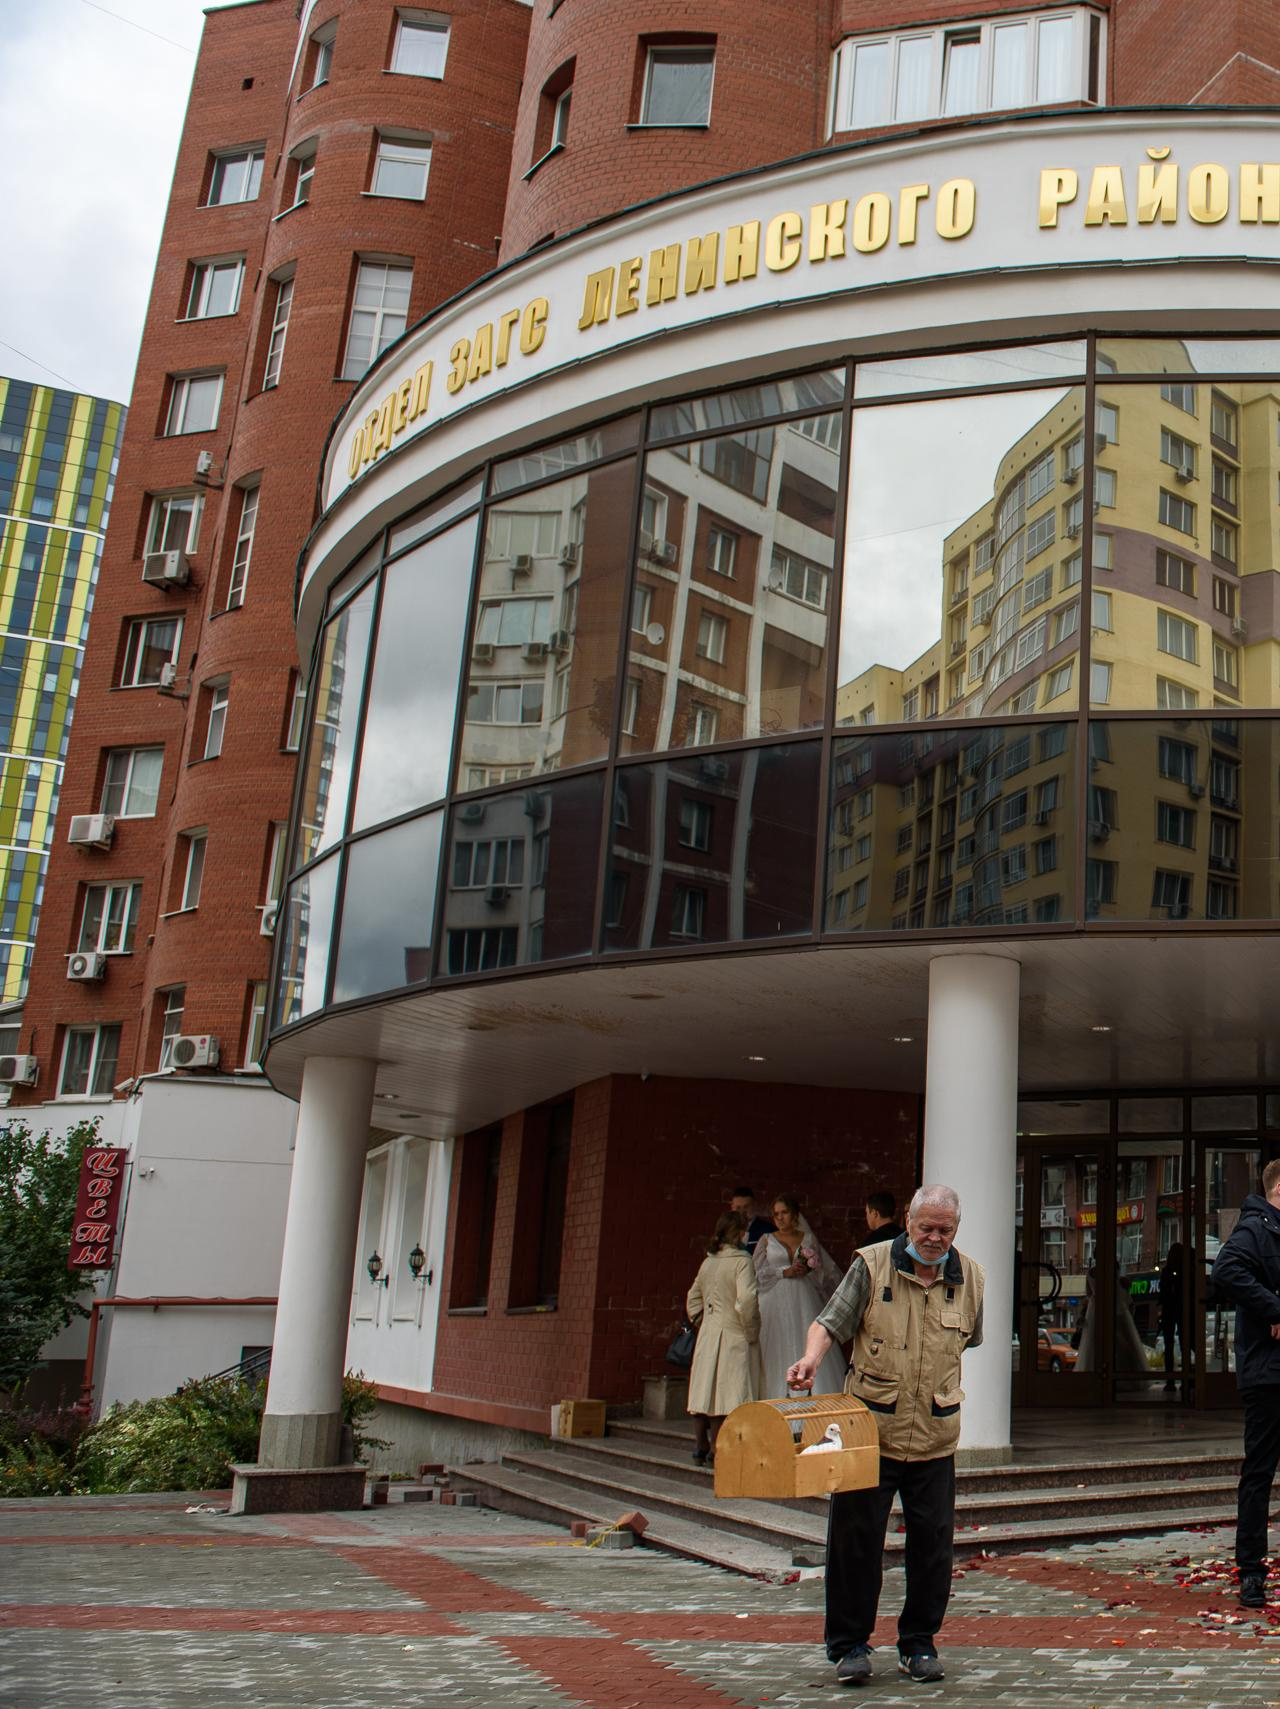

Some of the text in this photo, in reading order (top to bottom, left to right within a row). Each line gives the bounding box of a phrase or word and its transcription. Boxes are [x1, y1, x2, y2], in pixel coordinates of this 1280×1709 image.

[348, 360, 433, 480] ОТДЕЛ
[447, 297, 549, 395] ЗАГС
[578, 177, 976, 330] ЛЕНИНСКОГО
[72, 1151, 119, 1265] ЦВЕТЫ
